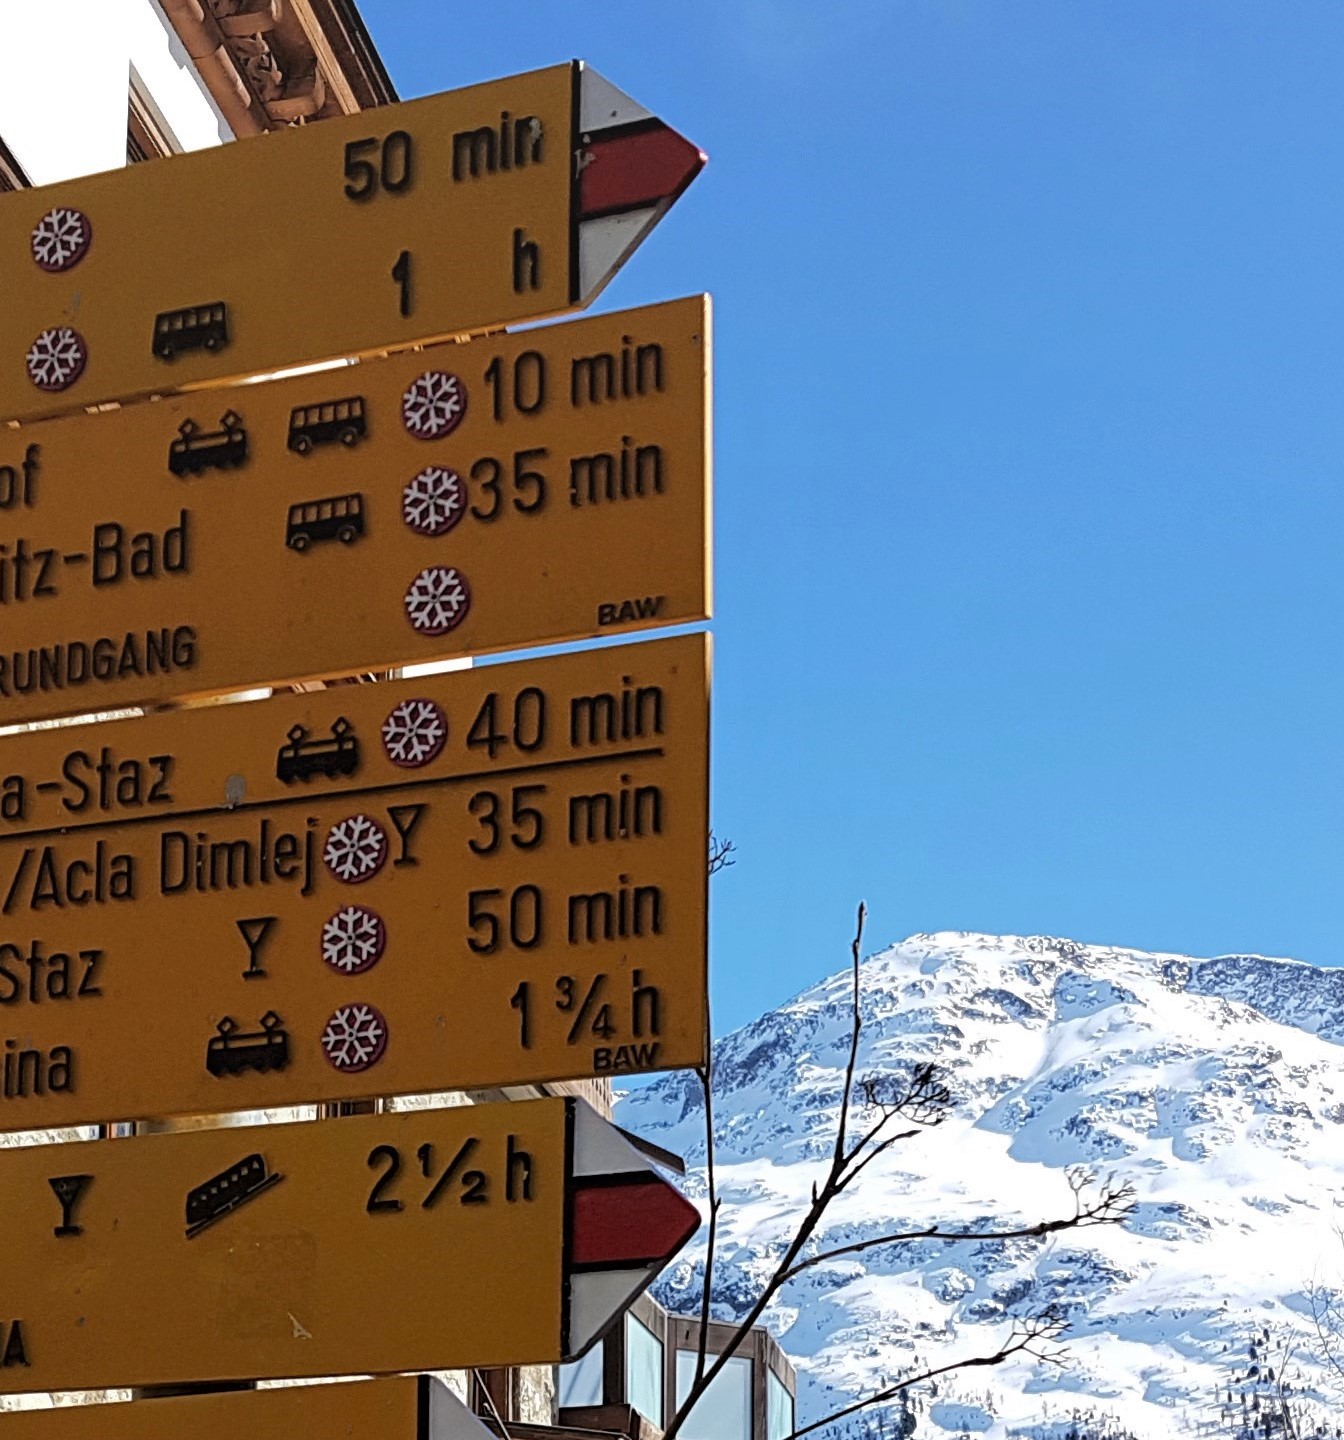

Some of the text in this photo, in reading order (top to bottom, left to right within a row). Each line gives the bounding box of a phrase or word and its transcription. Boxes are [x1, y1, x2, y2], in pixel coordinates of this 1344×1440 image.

[344, 110, 543, 201] 50 min
[392, 227, 540, 317] 1 h
[485, 335, 665, 422] 10 min
[470, 435, 664, 521] 35 min
[598, 596, 665, 626] BAW
[467, 675, 663, 758] 40 min
[468, 774, 662, 855] 35 min
[161, 817, 319, 895] Dimlej
[467, 874, 661, 953] 50 min
[593, 1043, 660, 1071] BAW
[507, 1134, 533, 1202] h
